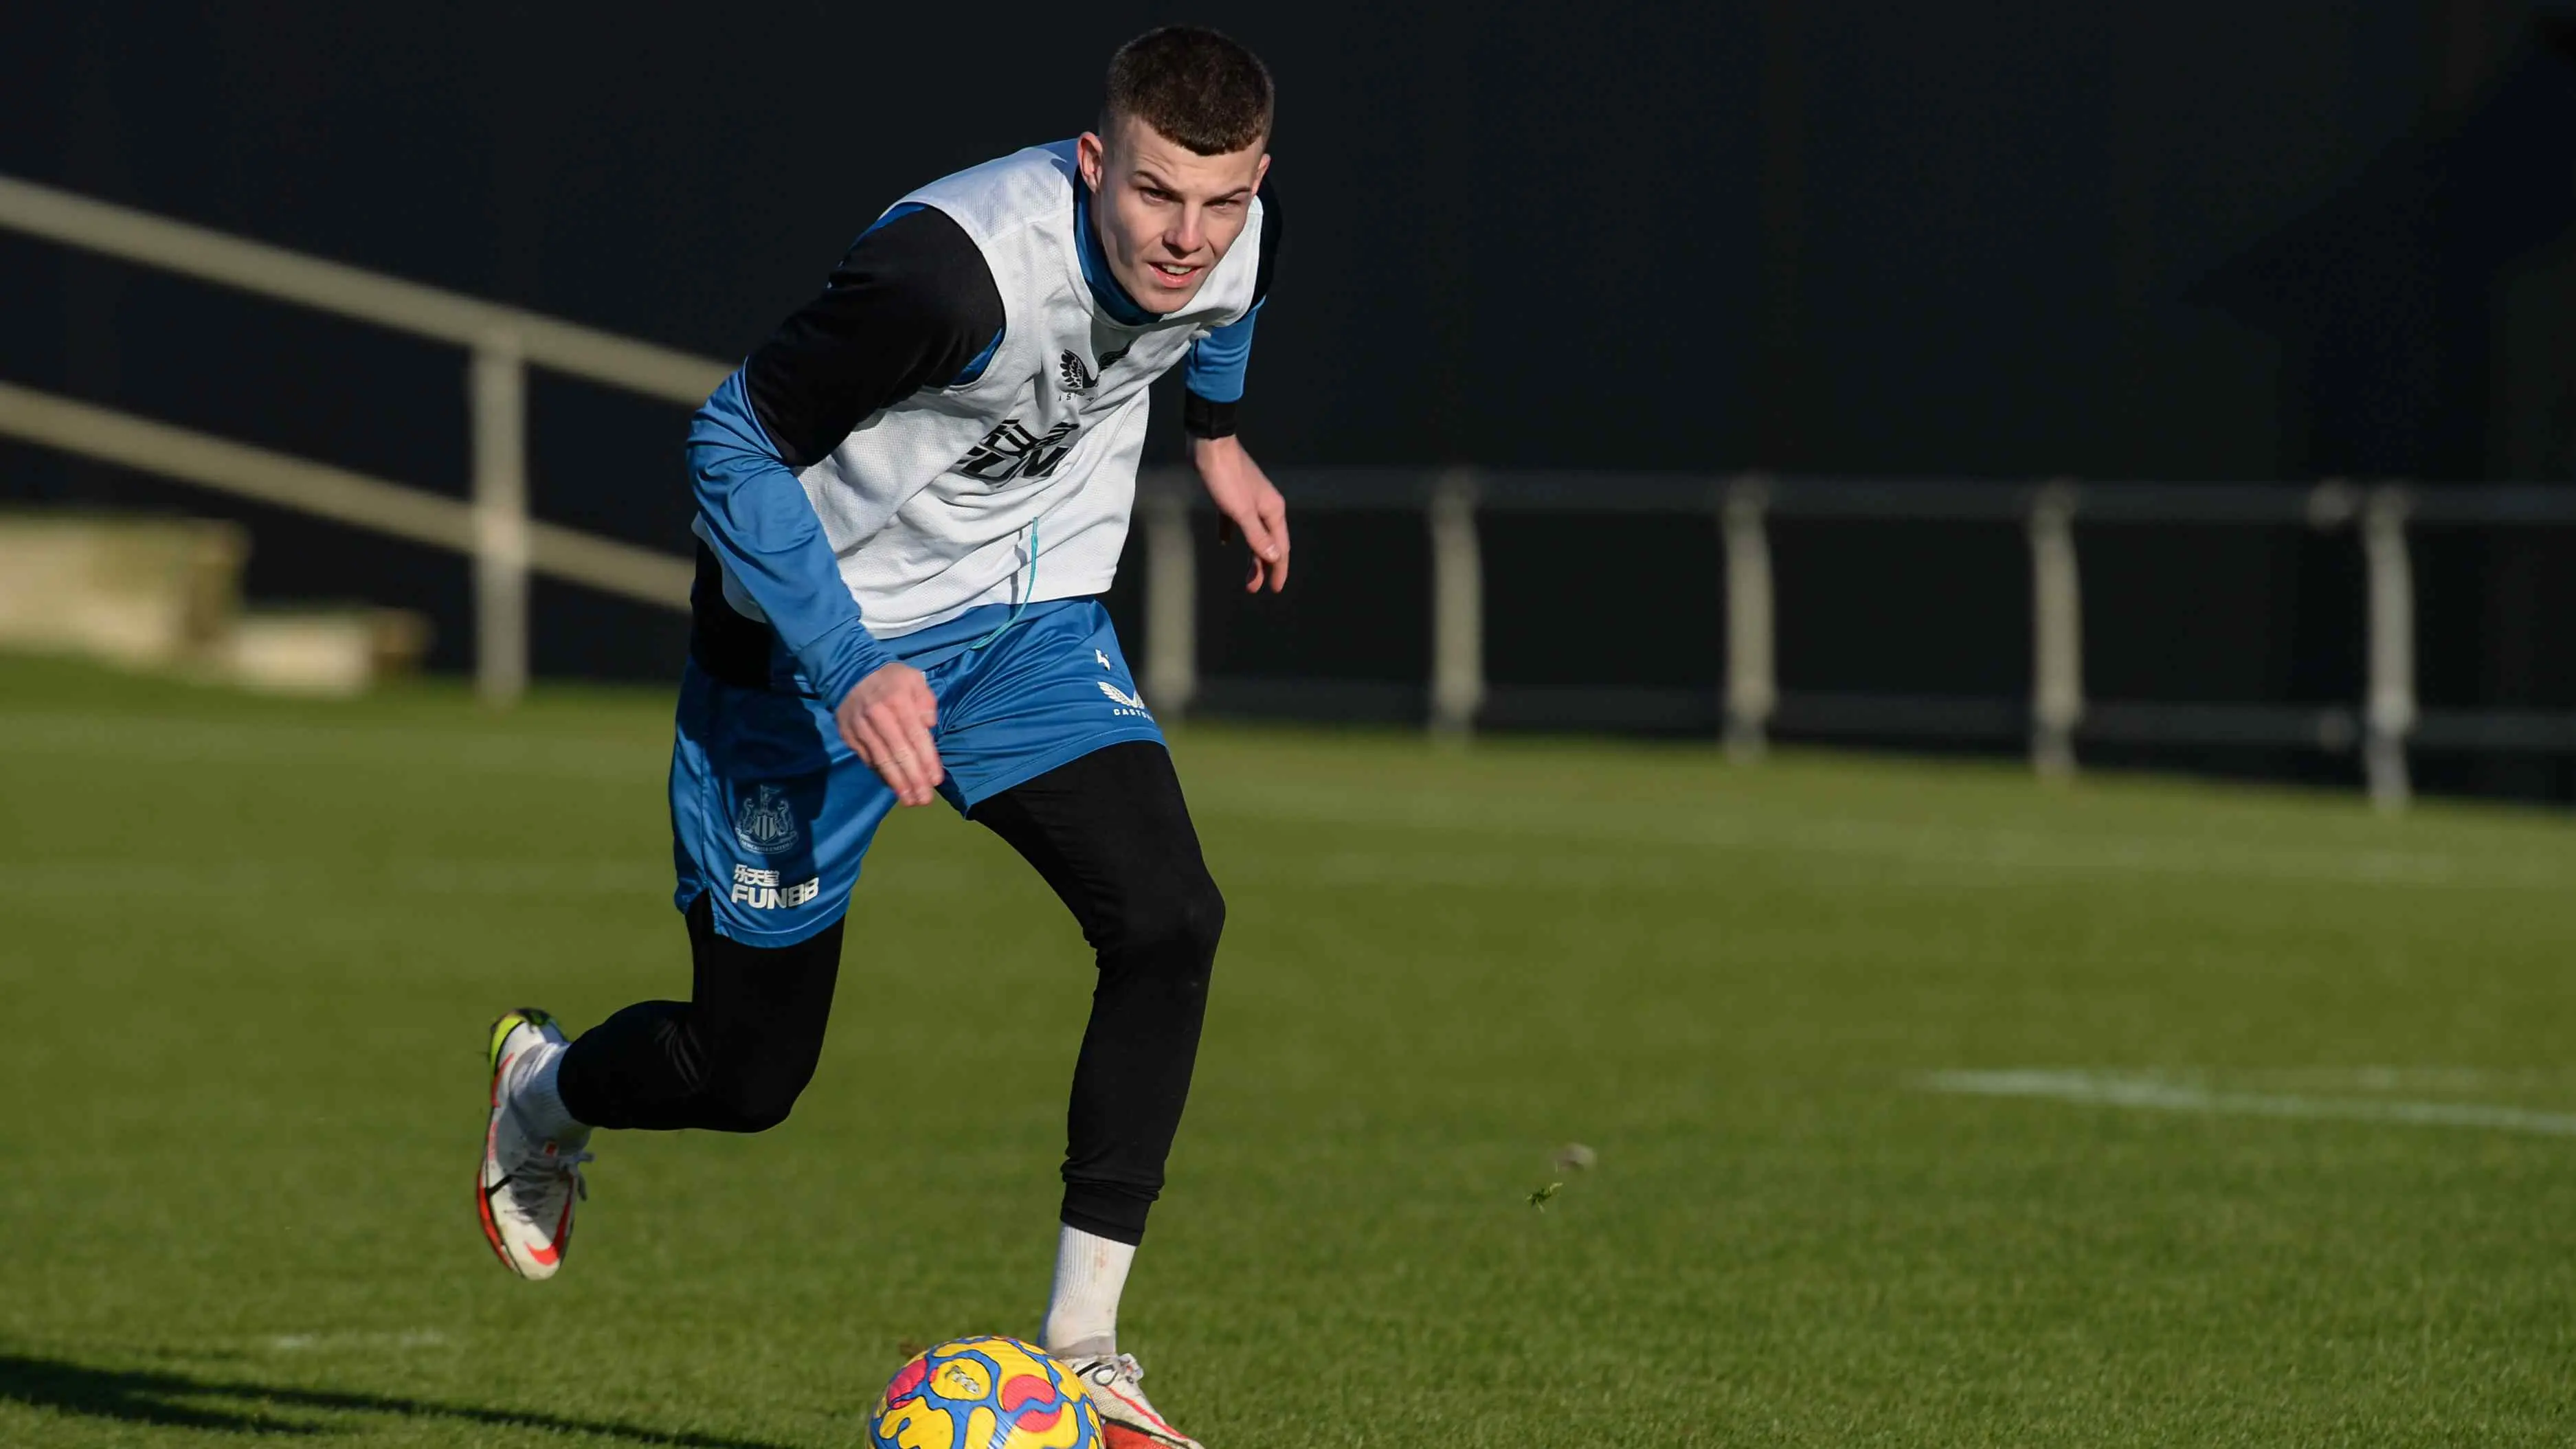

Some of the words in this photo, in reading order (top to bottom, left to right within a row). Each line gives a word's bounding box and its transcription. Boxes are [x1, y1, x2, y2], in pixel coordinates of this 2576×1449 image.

[733, 863, 779, 887] 乐天堂
[731, 877, 820, 910] FUN88
